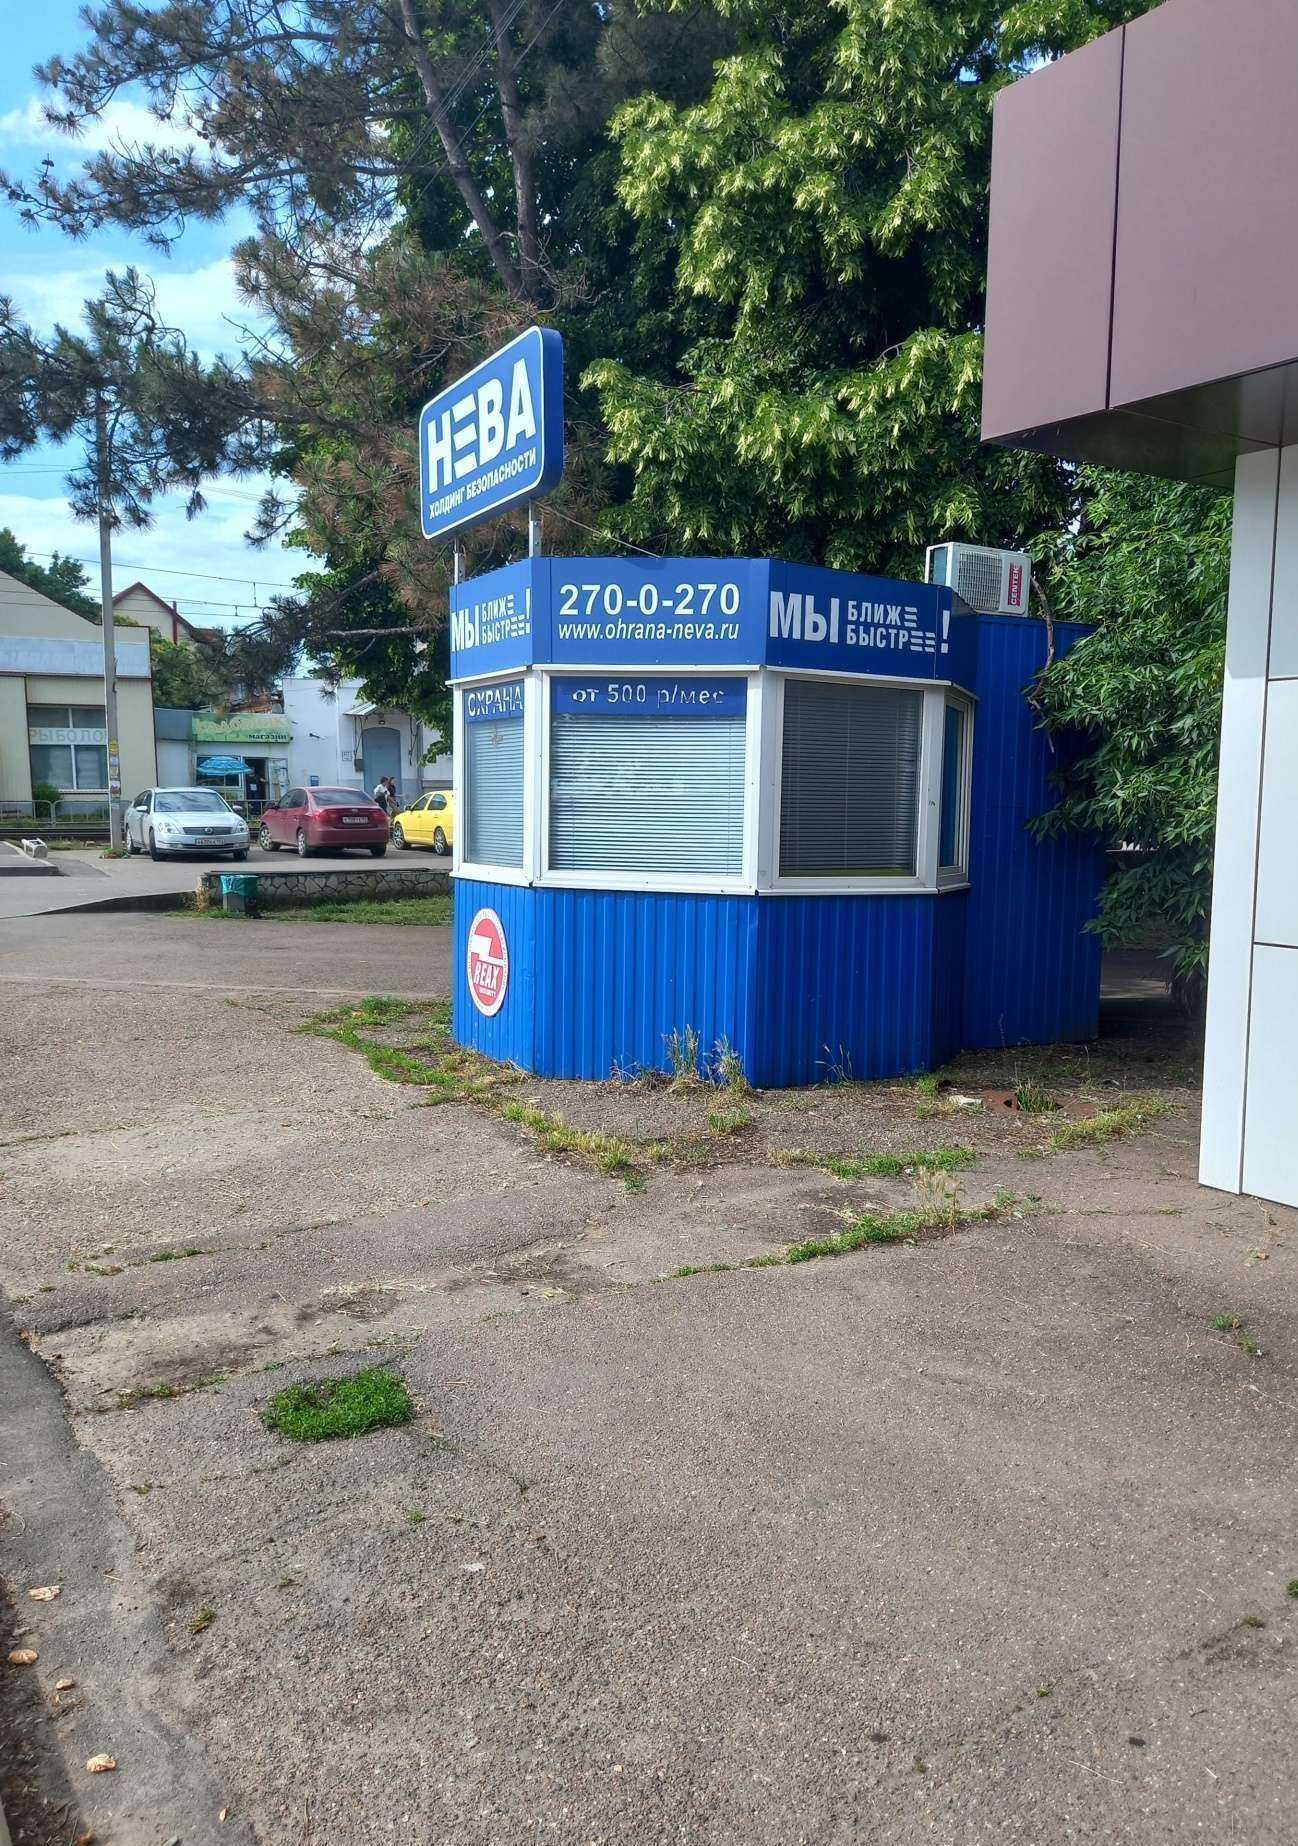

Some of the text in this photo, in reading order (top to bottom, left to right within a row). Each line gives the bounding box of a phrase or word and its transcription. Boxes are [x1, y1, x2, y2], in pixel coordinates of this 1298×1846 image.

[428, 359, 536, 493] НЕВА
[430, 448, 536, 519] ХОЛДИНГ БЕЗОПАСНОСТИ
[1010, 562, 1019, 605] CENTEK
[482, 595, 514, 622] БЛИЖЕ
[560, 584, 740, 616] 270-0-270
[847, 600, 918, 628] БЛИЖЕ
[451, 607, 480, 652] МЫ
[558, 619, 740, 640] www.ohrana-neva.ru
[770, 591, 839, 644] МЫ
[607, 684, 647, 703] 500
[30, 730, 106, 743] РЫБОЛО
